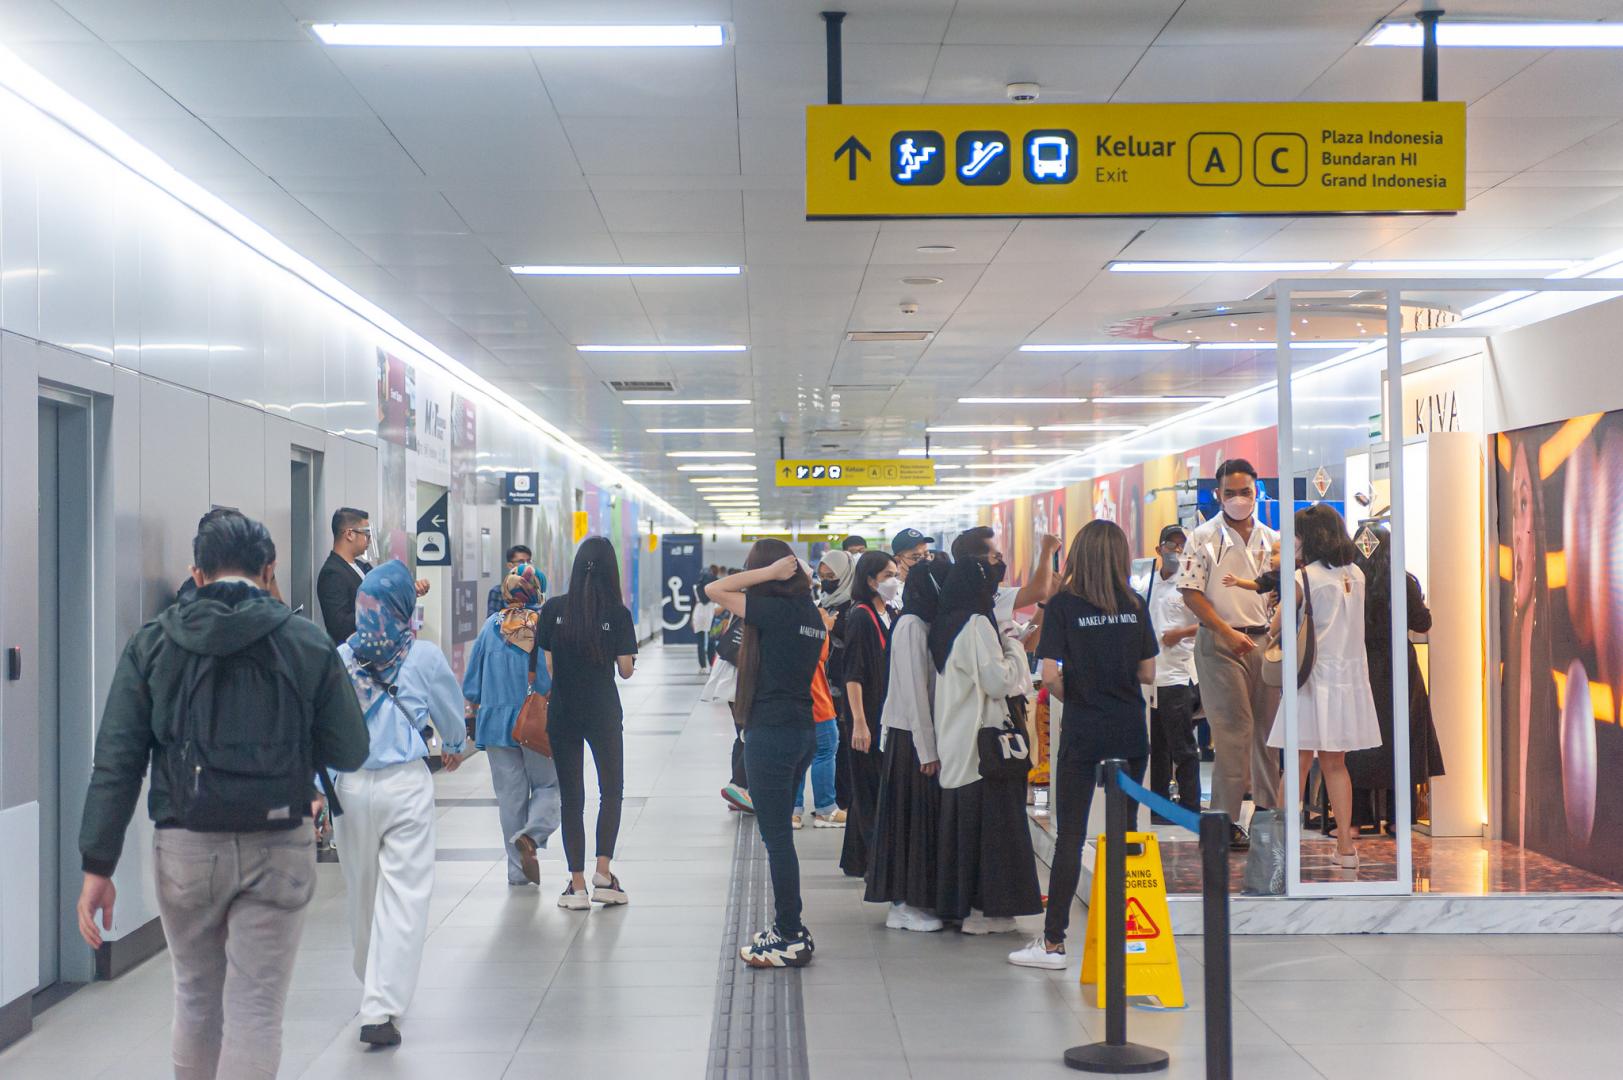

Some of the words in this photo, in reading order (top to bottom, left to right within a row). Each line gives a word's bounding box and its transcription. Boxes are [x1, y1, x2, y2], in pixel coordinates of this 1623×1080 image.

[1321, 129, 1363, 144] Plaza
[1368, 130, 1443, 145] Indonesia
[1096, 135, 1176, 157] Keluar
[1204, 147, 1226, 173] A
[1270, 147, 1289, 174] C
[1321, 151, 1396, 166] Bundaran
[1401, 152, 1417, 166] HI
[1096, 166, 1128, 183] Exit
[1321, 172, 1367, 187] Grand
[1371, 174, 1447, 188] Indonesia
[1416, 390, 1460, 434] KIVA
[1078, 615, 1106, 627] MAKEUP
[1108, 615, 1119, 624] MY
[1126, 870, 1151, 878] ANING
[1126, 879, 1157, 888] OGRESS
